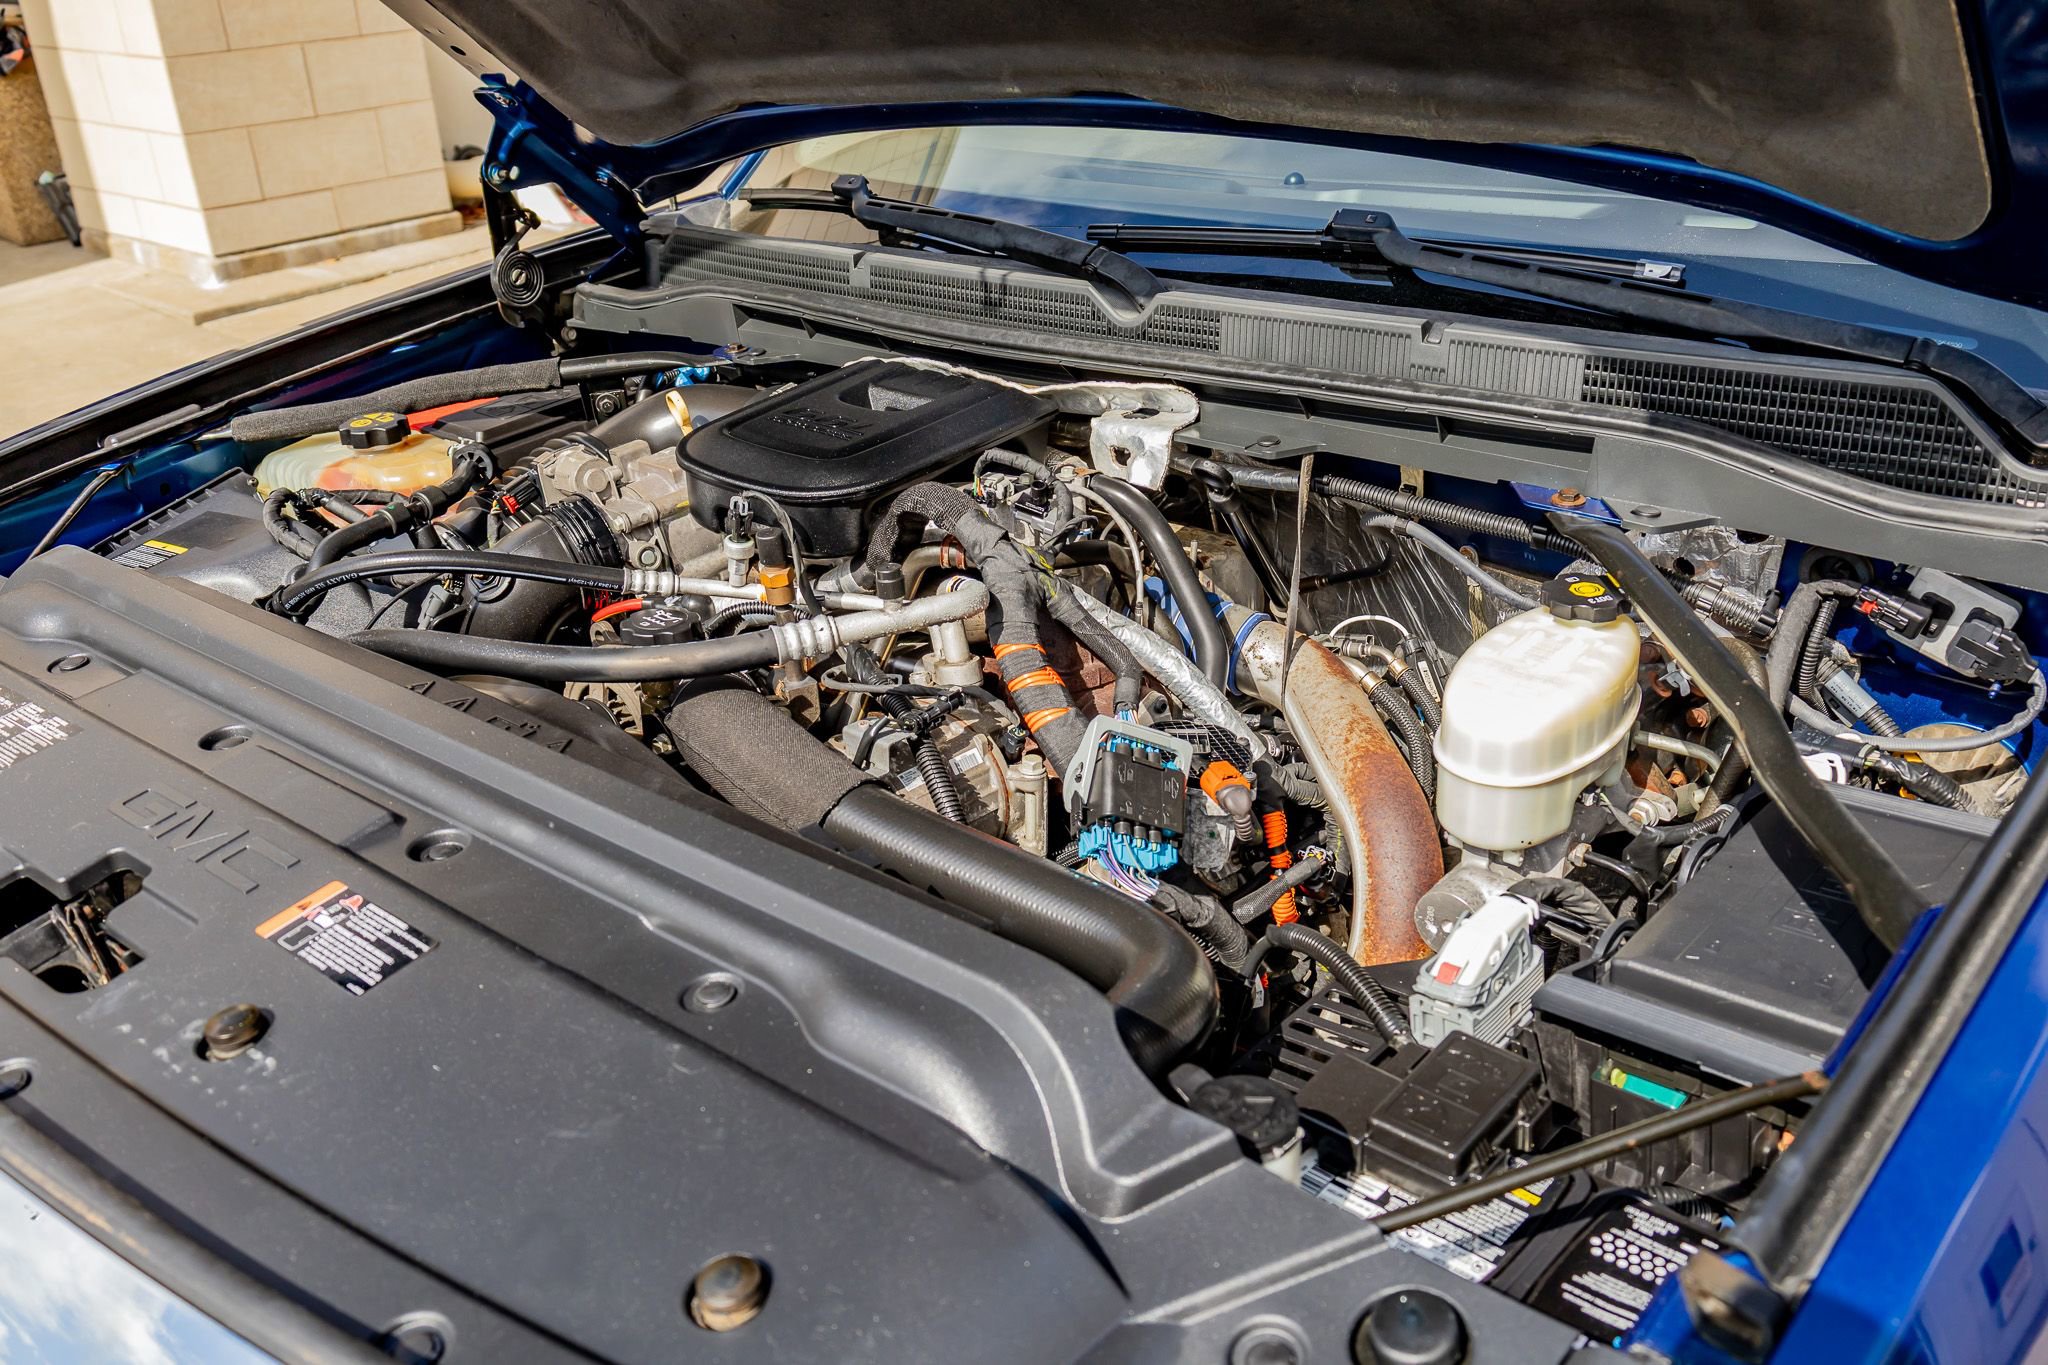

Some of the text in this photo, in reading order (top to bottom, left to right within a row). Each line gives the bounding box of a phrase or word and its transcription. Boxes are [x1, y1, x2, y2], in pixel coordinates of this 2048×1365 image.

[327, 573, 358, 585] GALAXY
[1587, 595, 1614, 604] DOT3
[107, 782, 301, 895] GMC
